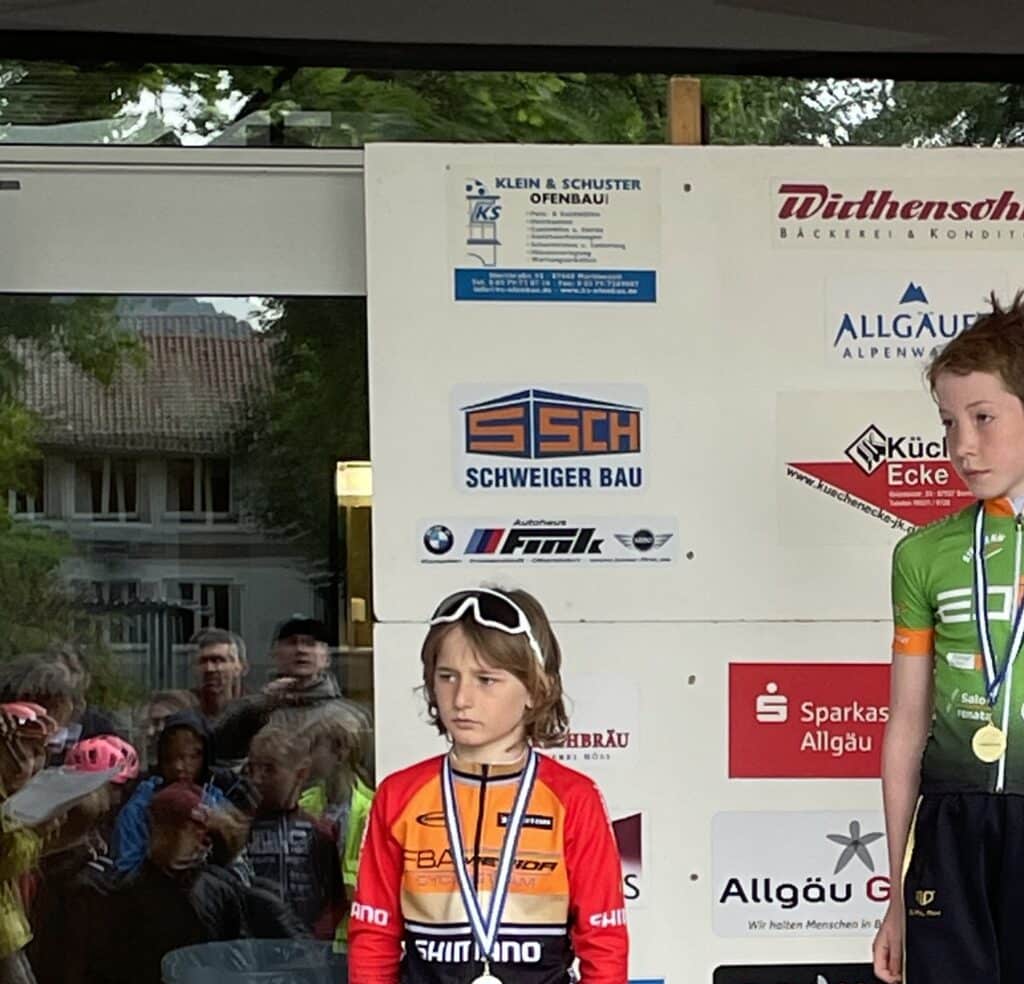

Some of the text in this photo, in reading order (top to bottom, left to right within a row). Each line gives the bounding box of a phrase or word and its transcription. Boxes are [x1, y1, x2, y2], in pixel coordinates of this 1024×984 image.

[495, 177, 642, 191] KLEIN & SCHUSTER
[474, 205, 502, 221] KS
[465, 467, 643, 488] SCHWEIGER BAU
[887, 463, 949, 486] Ecke
[800, 701, 889, 727] Sparkas
[800, 731, 872, 757] Allgäu
[719, 877, 852, 909] Allgäu
[748, 920, 766, 930] Wir
[806, 920, 859, 930] Menschen
